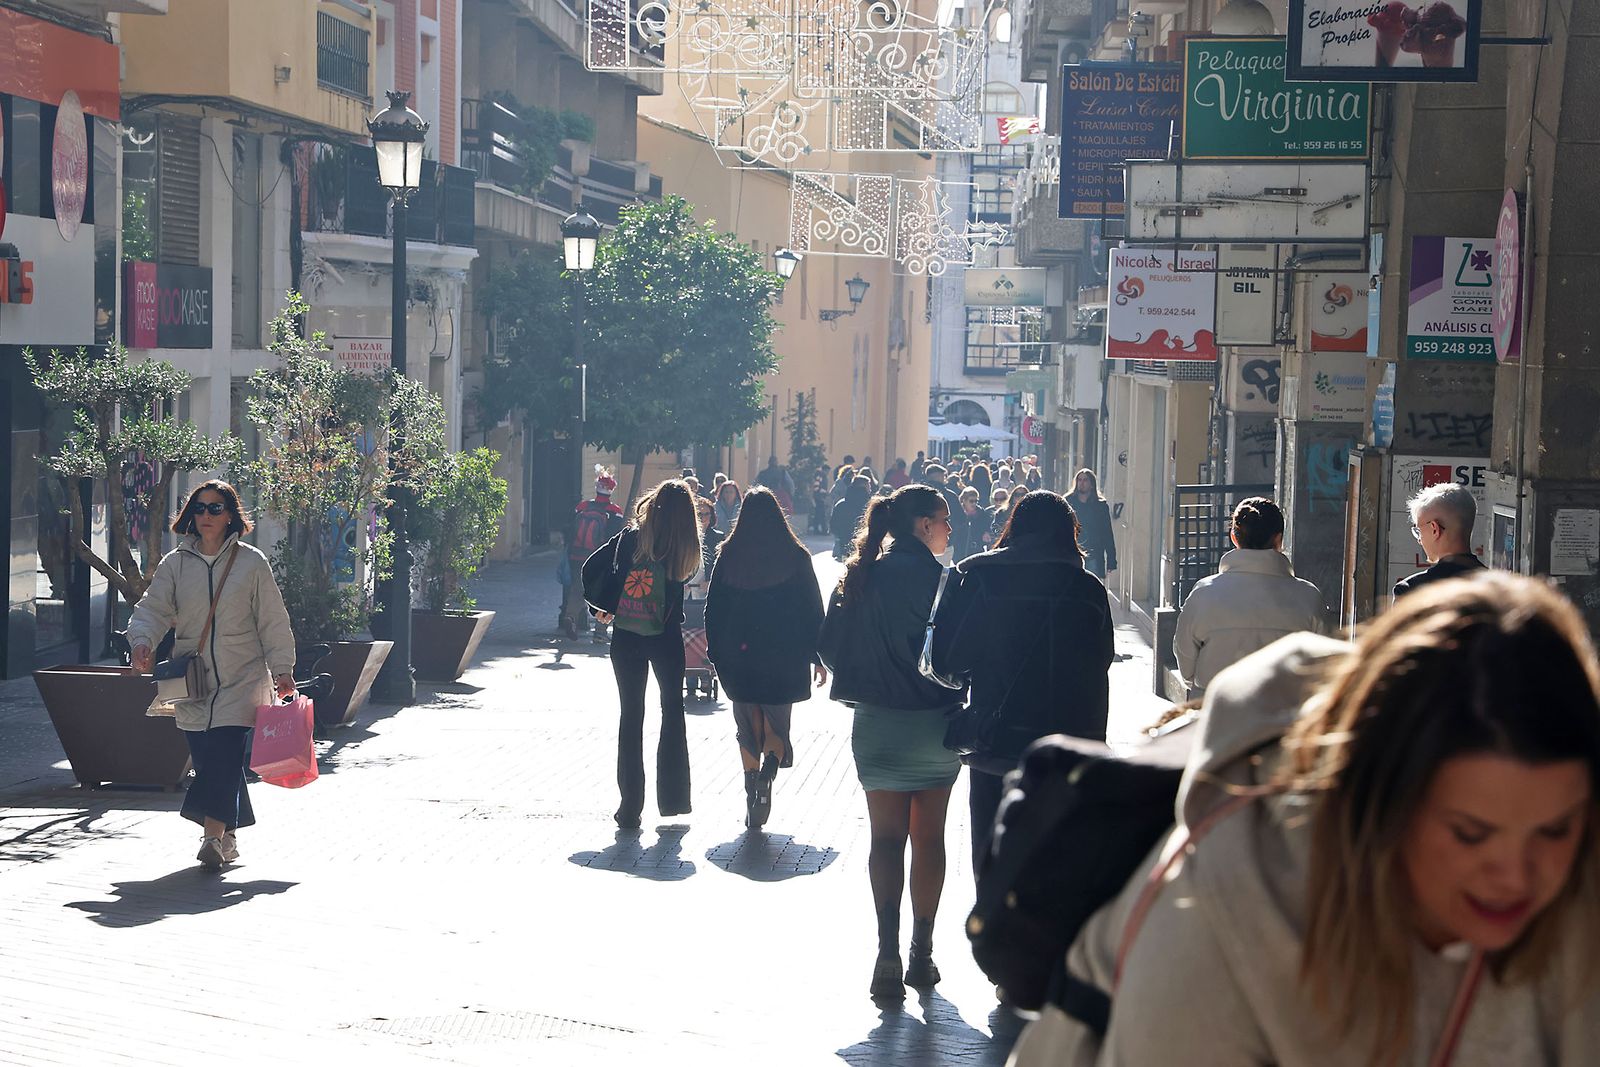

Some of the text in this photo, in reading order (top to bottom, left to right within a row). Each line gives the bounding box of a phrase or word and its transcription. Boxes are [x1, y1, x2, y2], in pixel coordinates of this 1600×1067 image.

[1308, 0, 1389, 29] Elaboración
[1321, 28, 1372, 48] Propia
[1198, 50, 1285, 74] Peluque
[1069, 71, 1111, 91] Salón
[1114, 71, 1134, 91] De
[1076, 96, 1128, 116] Luisa
[1194, 73, 1361, 134] Virginia
[1079, 121, 1154, 131] TRATAMIENTOS
[1079, 136, 1146, 145] MAQUILLAJES
[1284, 141, 1362, 149] Tel.: 959 26 16 55
[1078, 149, 1179, 158] MICROPIGMENTACO
[1180, 256, 1215, 269] Israel
[1149, 274, 1191, 282] PELUQUEROS
[1233, 282, 1261, 294] GIL
[1138, 306, 1196, 316] T. 959.242.544
[137, 309, 155, 331] KASE
[1424, 319, 1494, 333] ANÁLISIS CL
[350, 342, 383, 351] BAZAR
[1414, 341, 1492, 355] 959 248 923
[1455, 465, 1487, 487] SE
